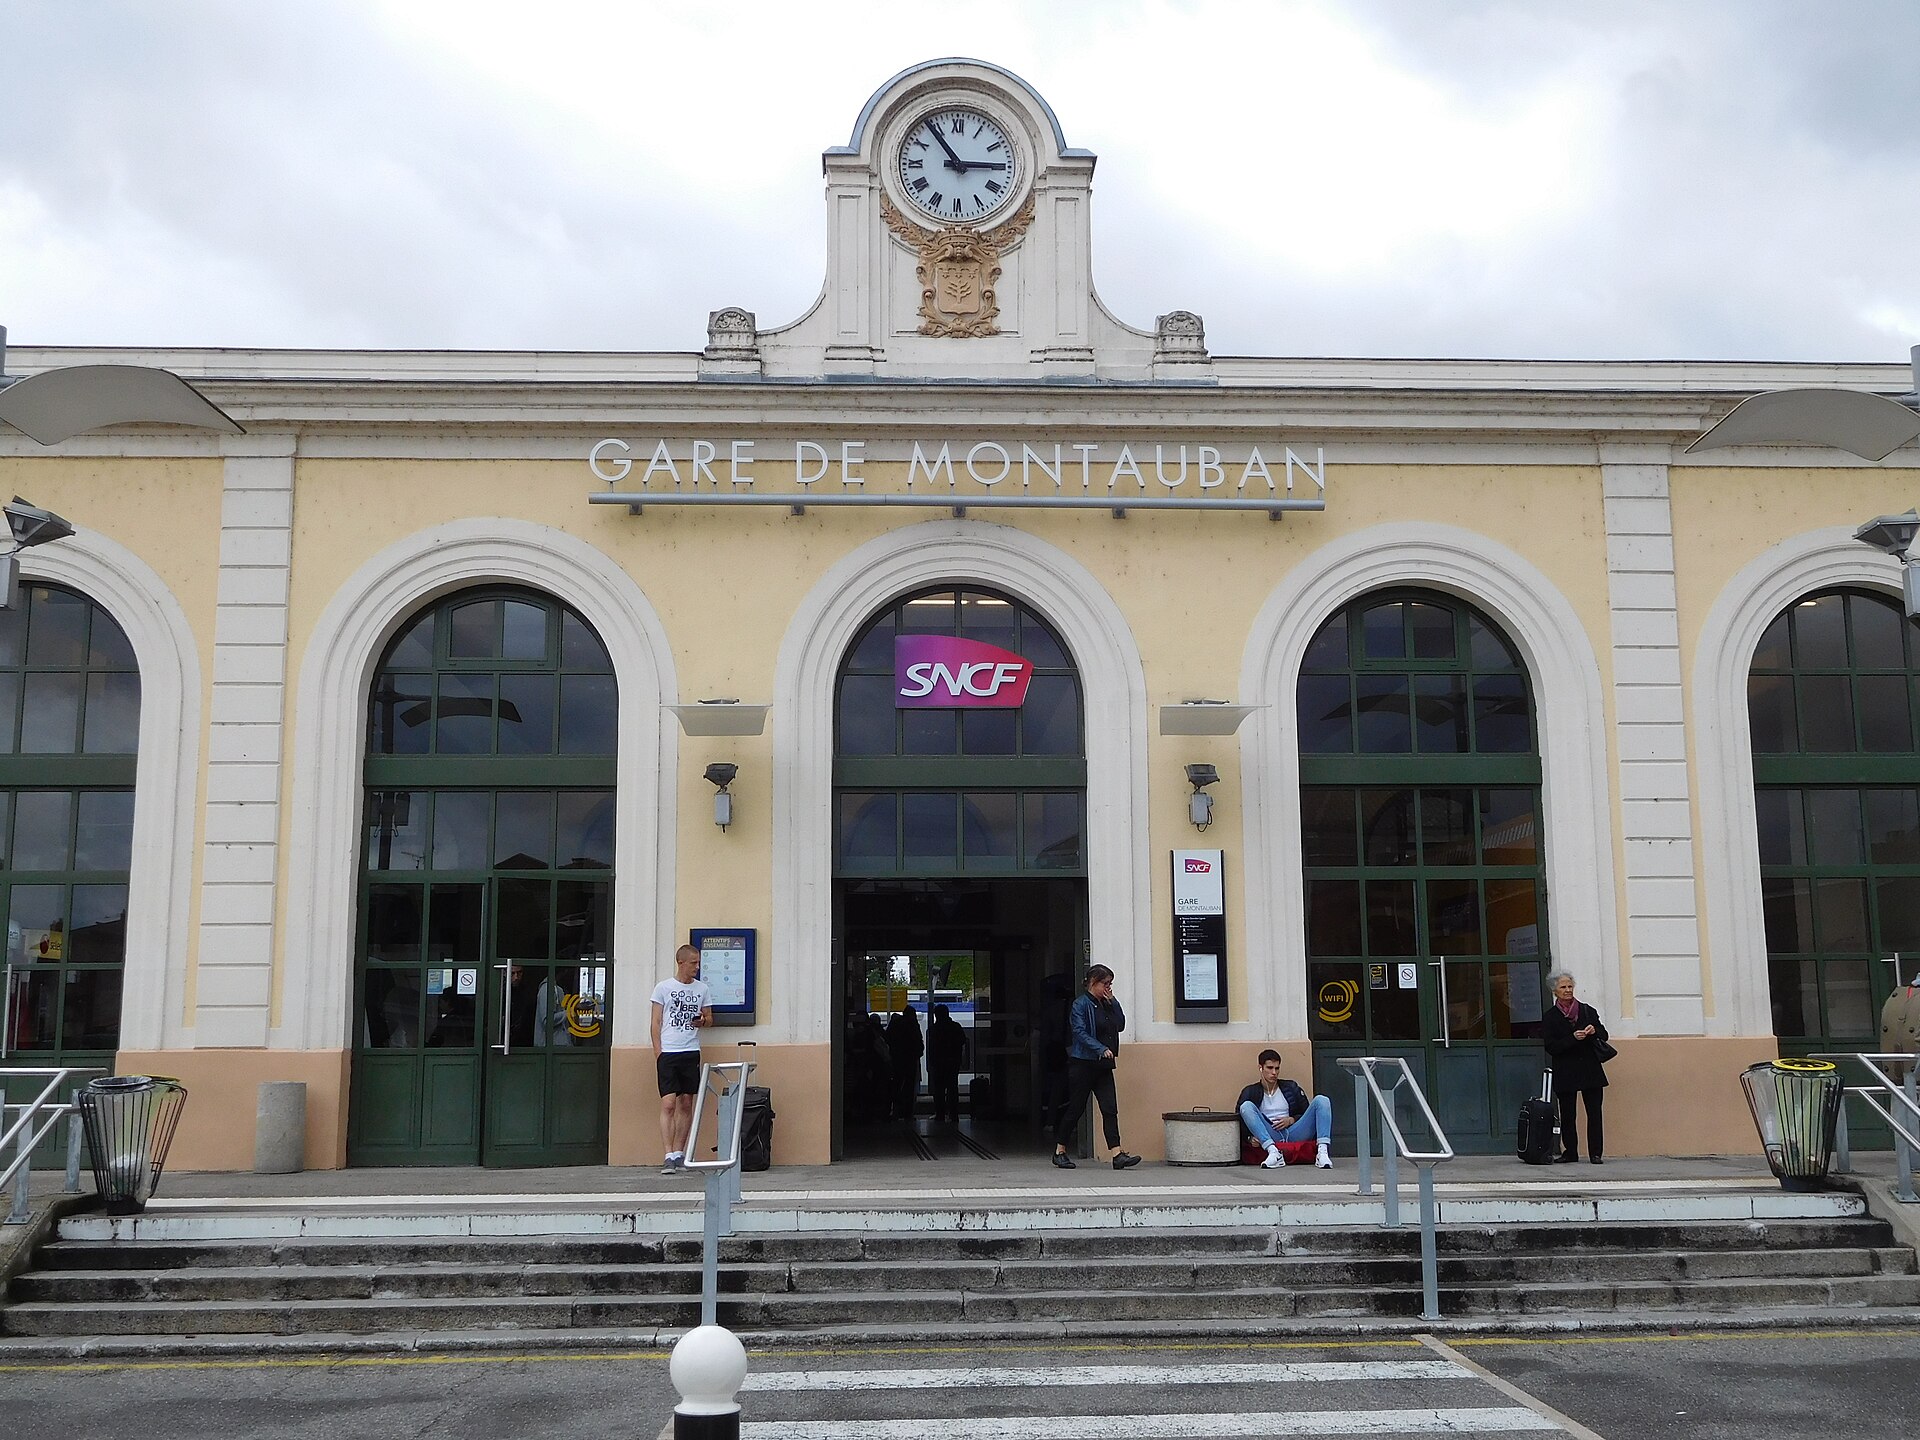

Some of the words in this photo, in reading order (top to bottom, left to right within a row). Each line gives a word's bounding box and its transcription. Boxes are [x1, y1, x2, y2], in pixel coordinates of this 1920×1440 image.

[951, 119, 964, 136] XII
[973, 125, 983, 139] I
[913, 138, 929, 151] X
[987, 141, 1001, 152] II
[908, 158, 923, 169] IX
[973, 194, 984, 208] V
[588, 437, 756, 484] GARE
[796, 441, 866, 485] DE
[907, 440, 1326, 491] MONTAUBAN
[899, 662, 1024, 697] SNCF
[1186, 864, 1210, 872] SNCF
[671, 991, 698, 1003] GOOD
[1324, 994, 1344, 1002] WIFI
[674, 1000, 698, 1012] VIBES
[671, 1019, 695, 1031] LIVES
